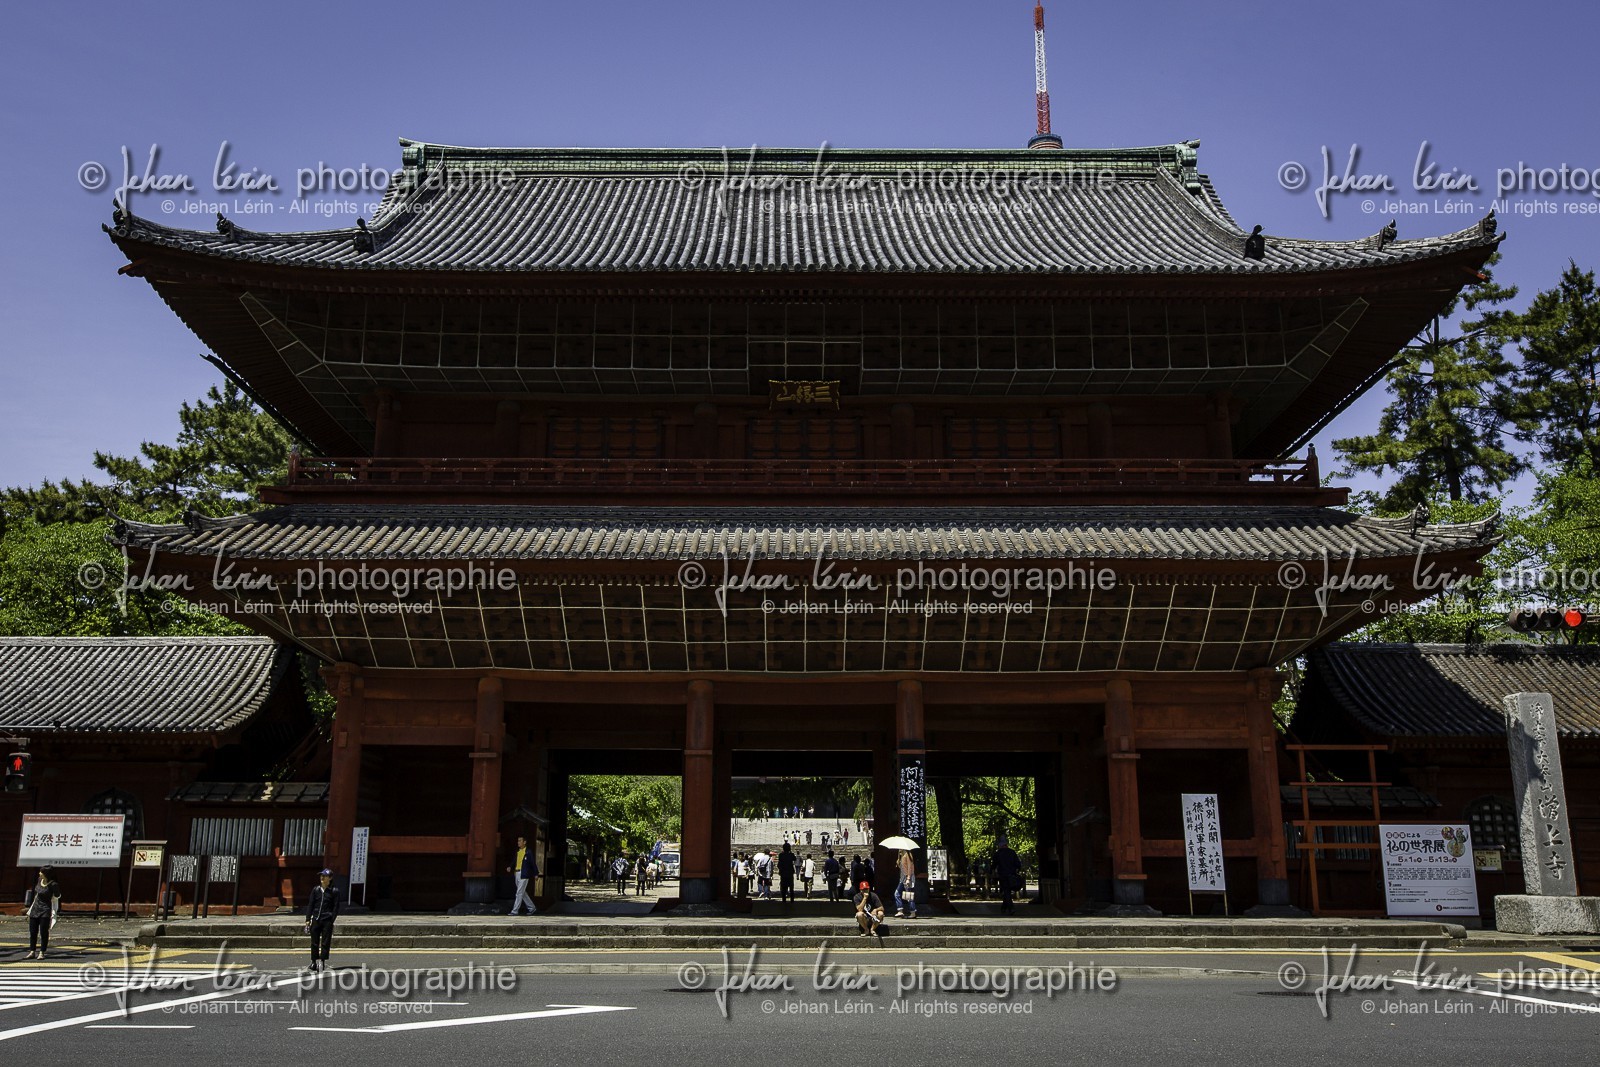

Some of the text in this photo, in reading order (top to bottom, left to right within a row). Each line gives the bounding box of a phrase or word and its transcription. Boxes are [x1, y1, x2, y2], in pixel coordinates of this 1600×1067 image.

[1204, 796, 1219, 843] 特別公開
[25, 833, 84, 847] 法然共生
[1192, 802, 1209, 881] 徳川将軍家墓所
[1386, 840, 1447, 853] 仏の世界展
